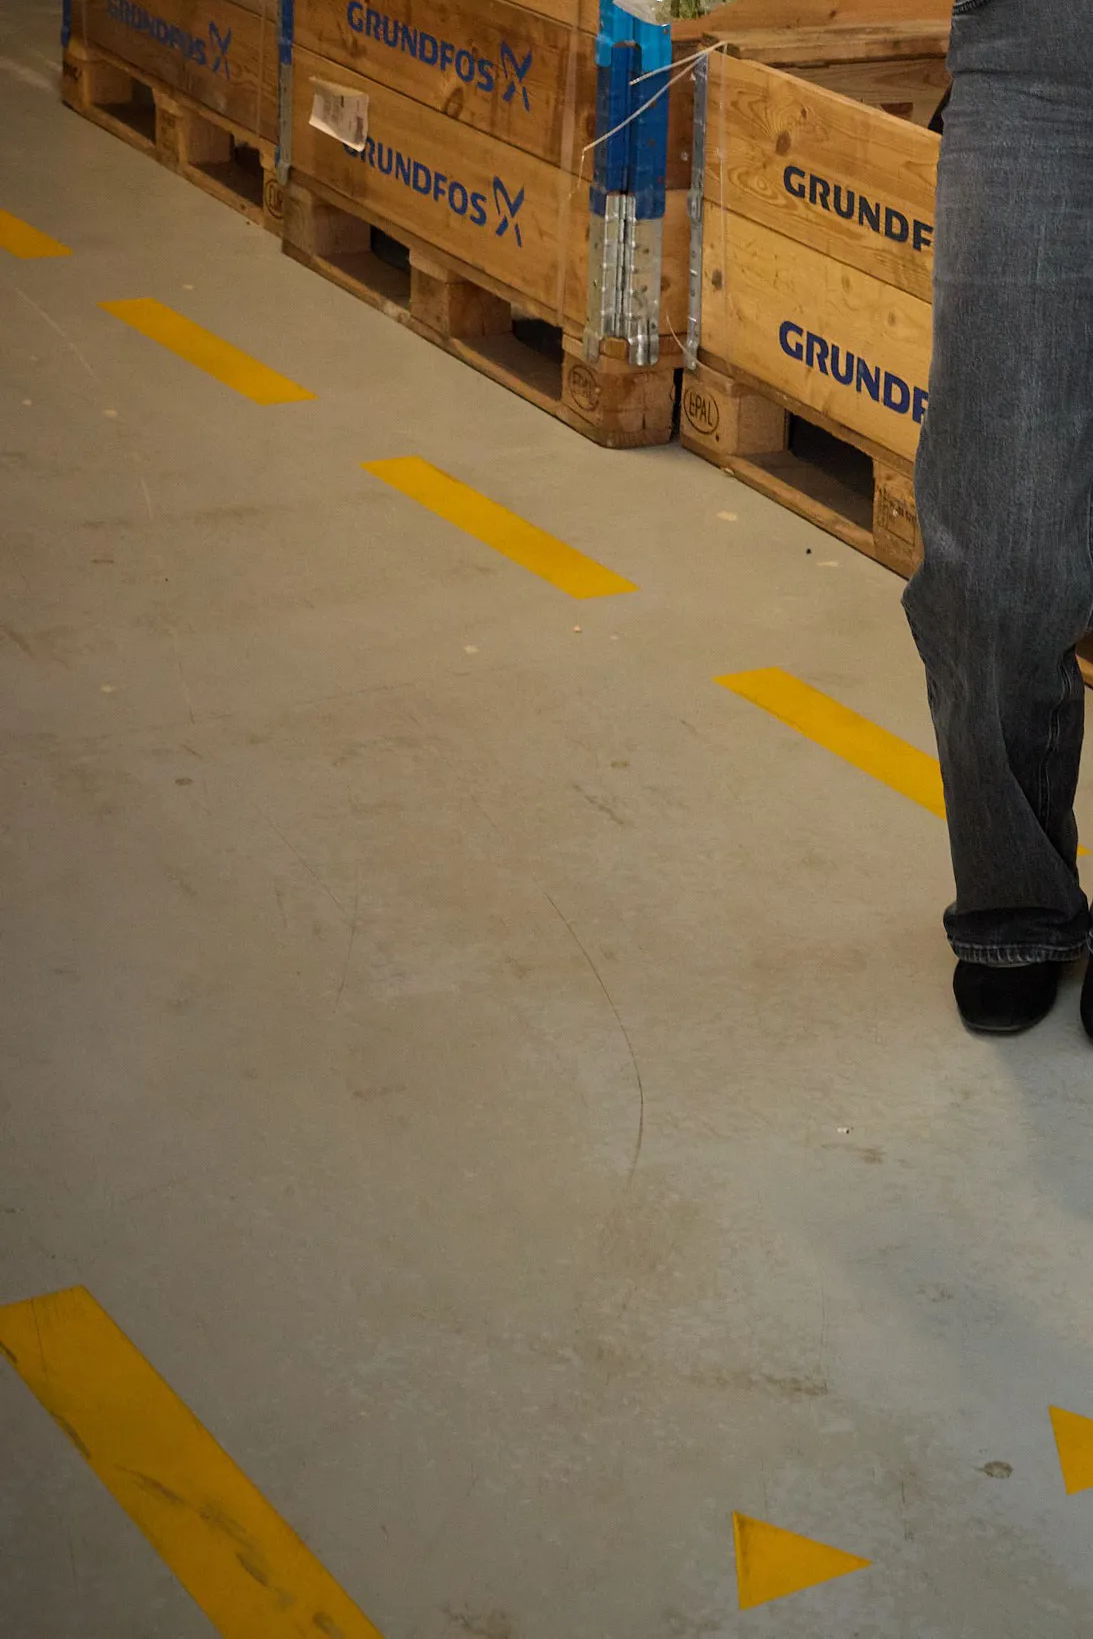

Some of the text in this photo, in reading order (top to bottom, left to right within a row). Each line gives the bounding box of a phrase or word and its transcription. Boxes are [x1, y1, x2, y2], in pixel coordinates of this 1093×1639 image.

[347, 0, 496, 92] GRUNDFOS
[783, 165, 935, 252] GRUNDF
[688, 391, 713, 427] EPAL
[779, 320, 930, 424] GRUNDF
